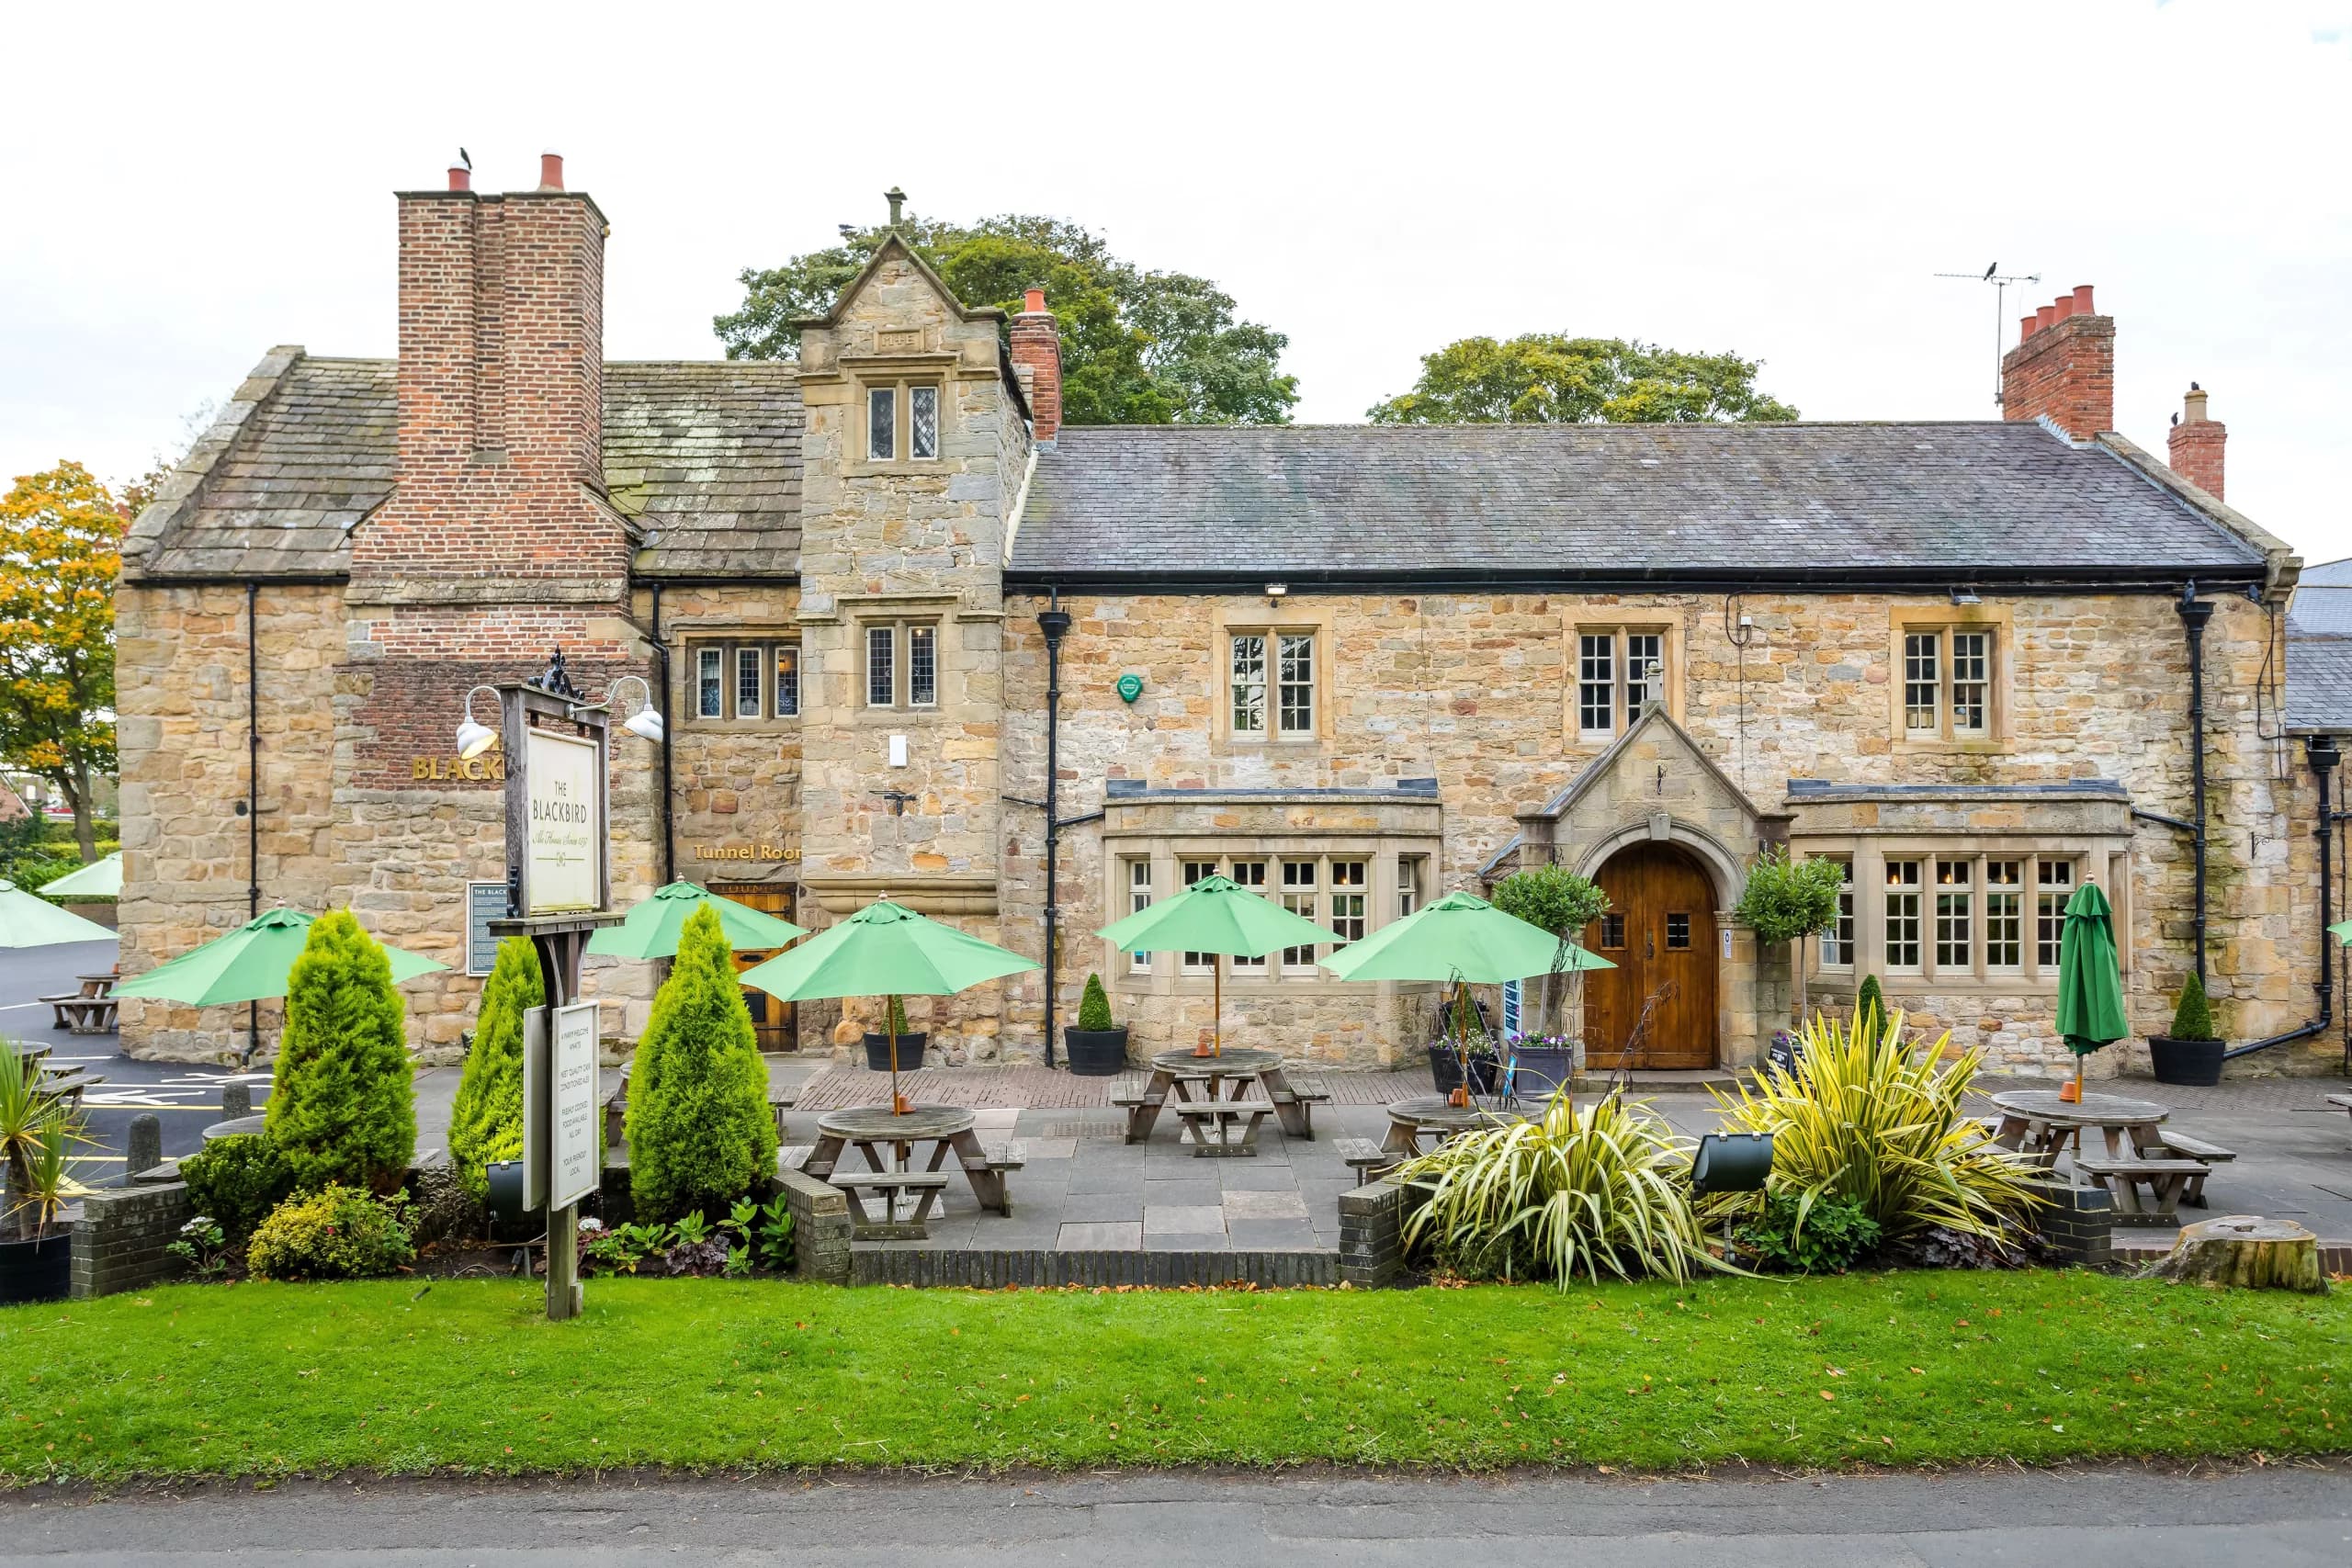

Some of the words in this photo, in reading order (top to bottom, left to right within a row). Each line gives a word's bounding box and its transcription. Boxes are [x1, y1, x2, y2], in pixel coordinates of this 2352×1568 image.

[412, 756, 505, 781] BLACK
[554, 781, 567, 796] THE
[533, 799, 587, 824] BLACKBIRD
[694, 844, 754, 860] Tunnel
